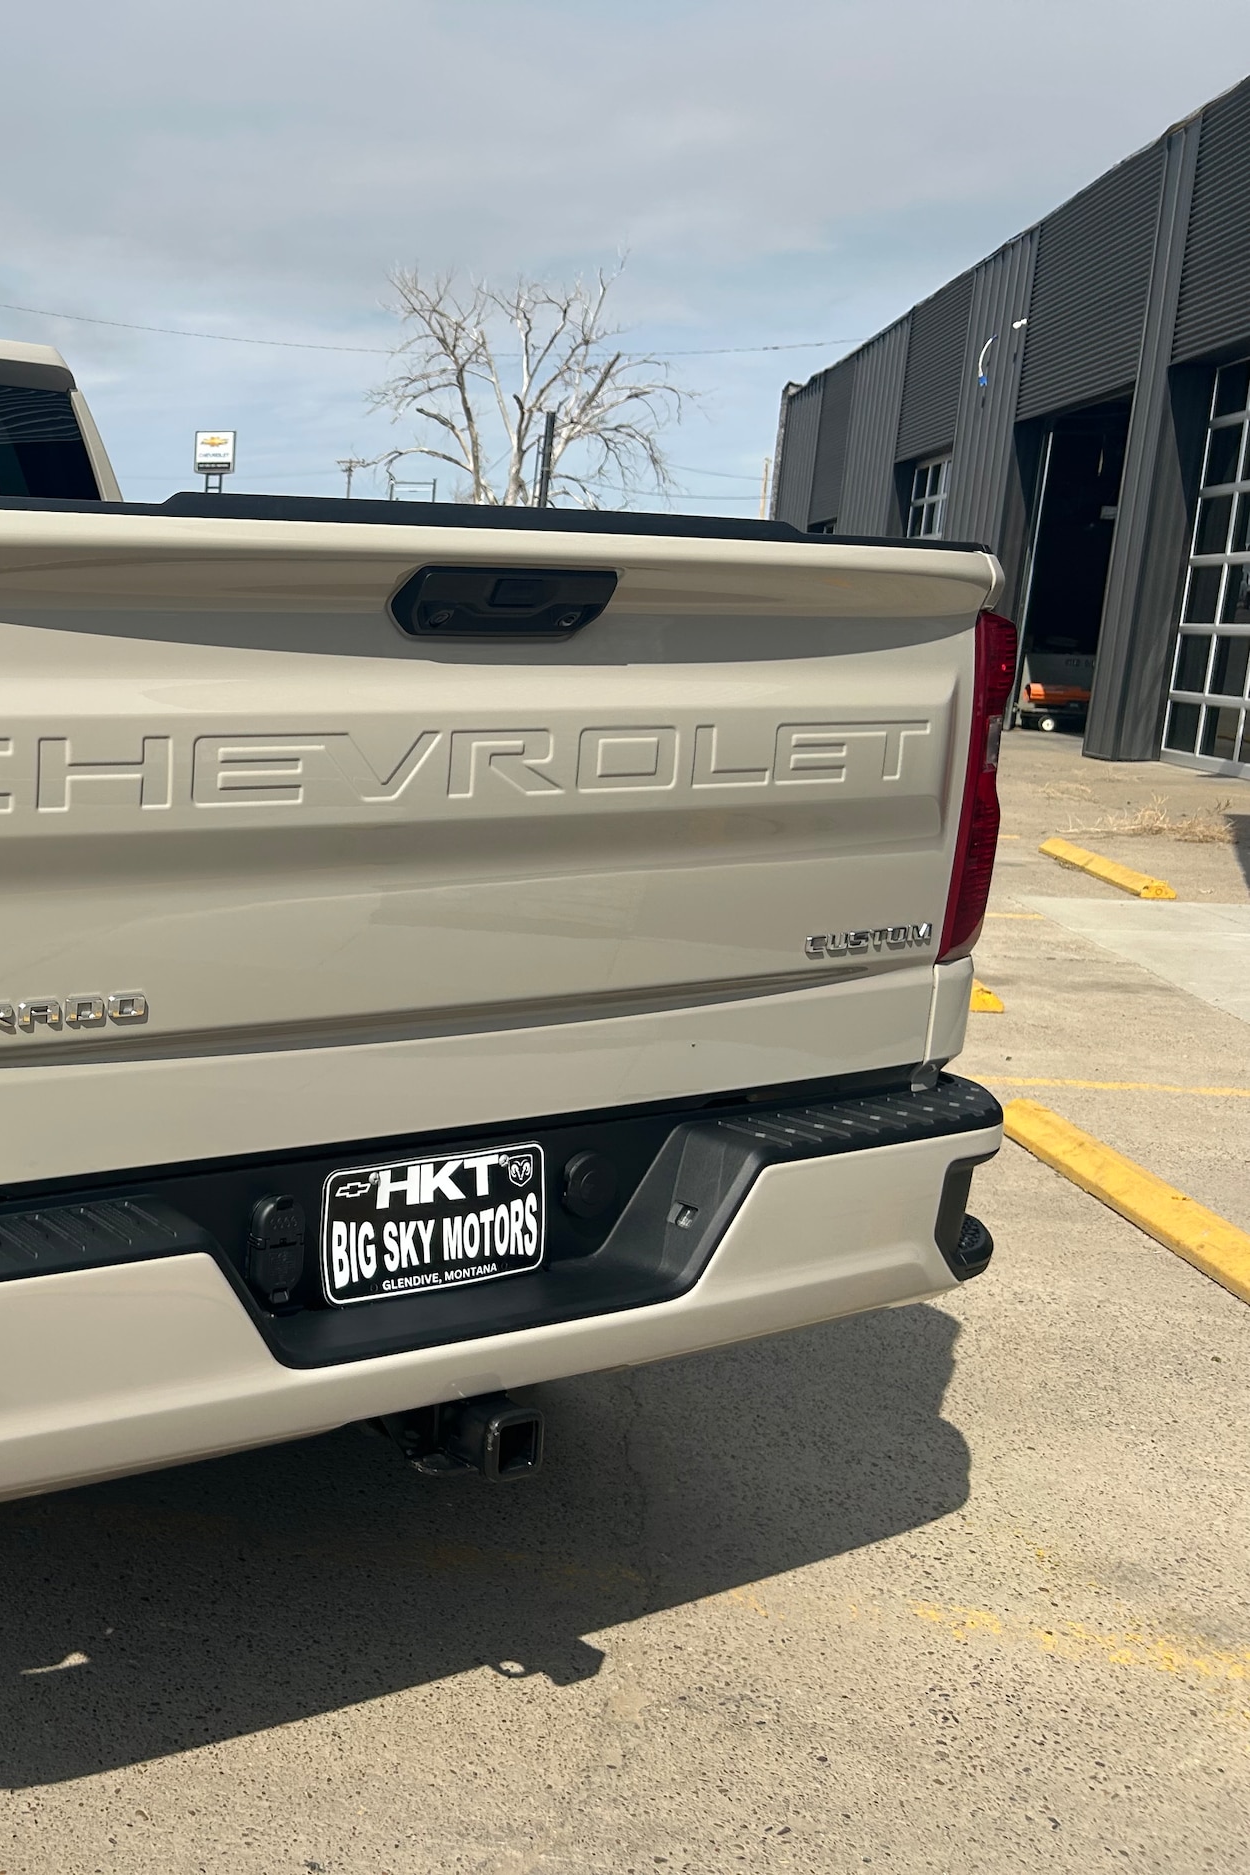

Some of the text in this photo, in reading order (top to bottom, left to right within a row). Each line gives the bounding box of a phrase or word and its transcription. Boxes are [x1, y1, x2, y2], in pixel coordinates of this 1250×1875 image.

[805, 922, 932, 955] CUSTOM
[376, 1154, 499, 1210] HKT
[332, 1220, 377, 1289] BIG
[383, 1219, 435, 1272] SKY
[442, 1192, 539, 1261] MOTORS
[382, 1262, 498, 1292] GLENDIVE, MONTANA
